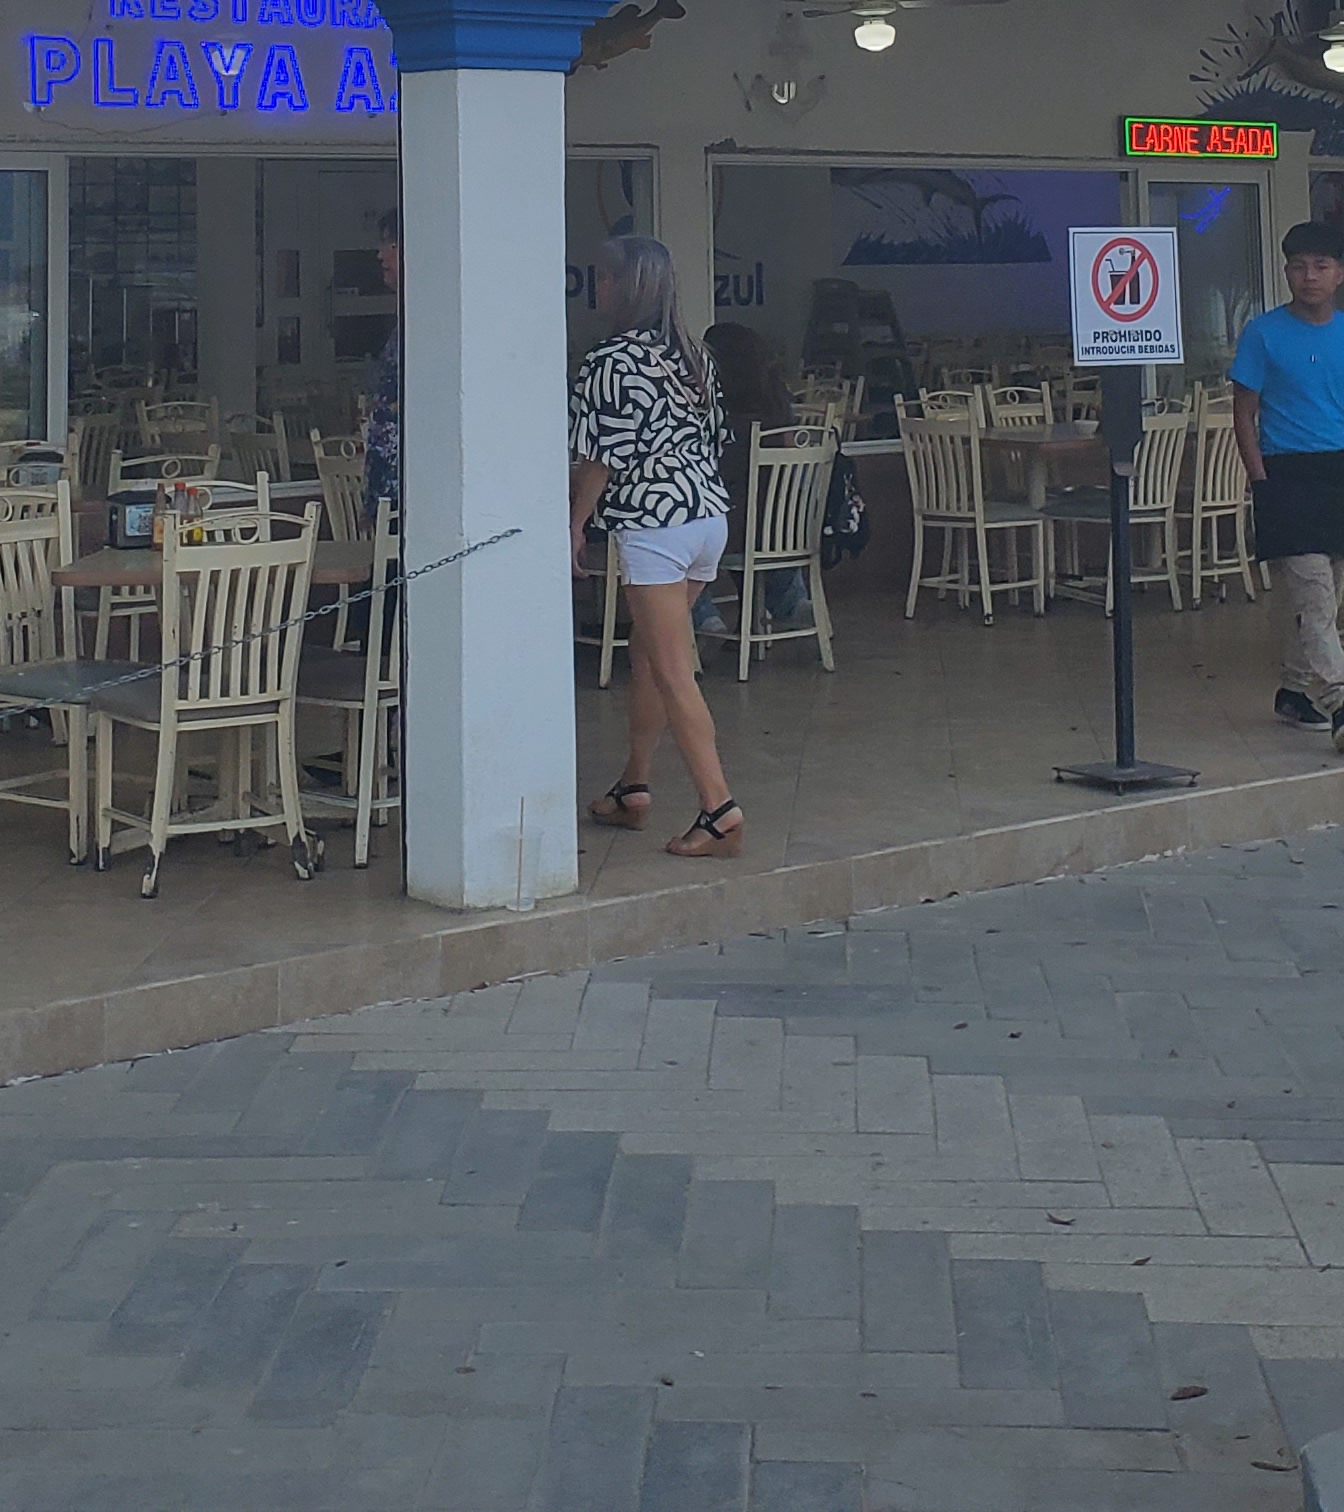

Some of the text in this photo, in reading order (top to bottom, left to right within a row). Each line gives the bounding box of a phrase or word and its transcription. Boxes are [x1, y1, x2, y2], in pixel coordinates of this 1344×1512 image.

[28, 35, 397, 113] PLAYA A
[1130, 122, 1201, 155] CARNE
[1205, 125, 1274, 156] ASADA
[1092, 329, 1162, 344] PROHIBIDO
[1081, 344, 1176, 356] INTRODUCIR BEBIDAS
